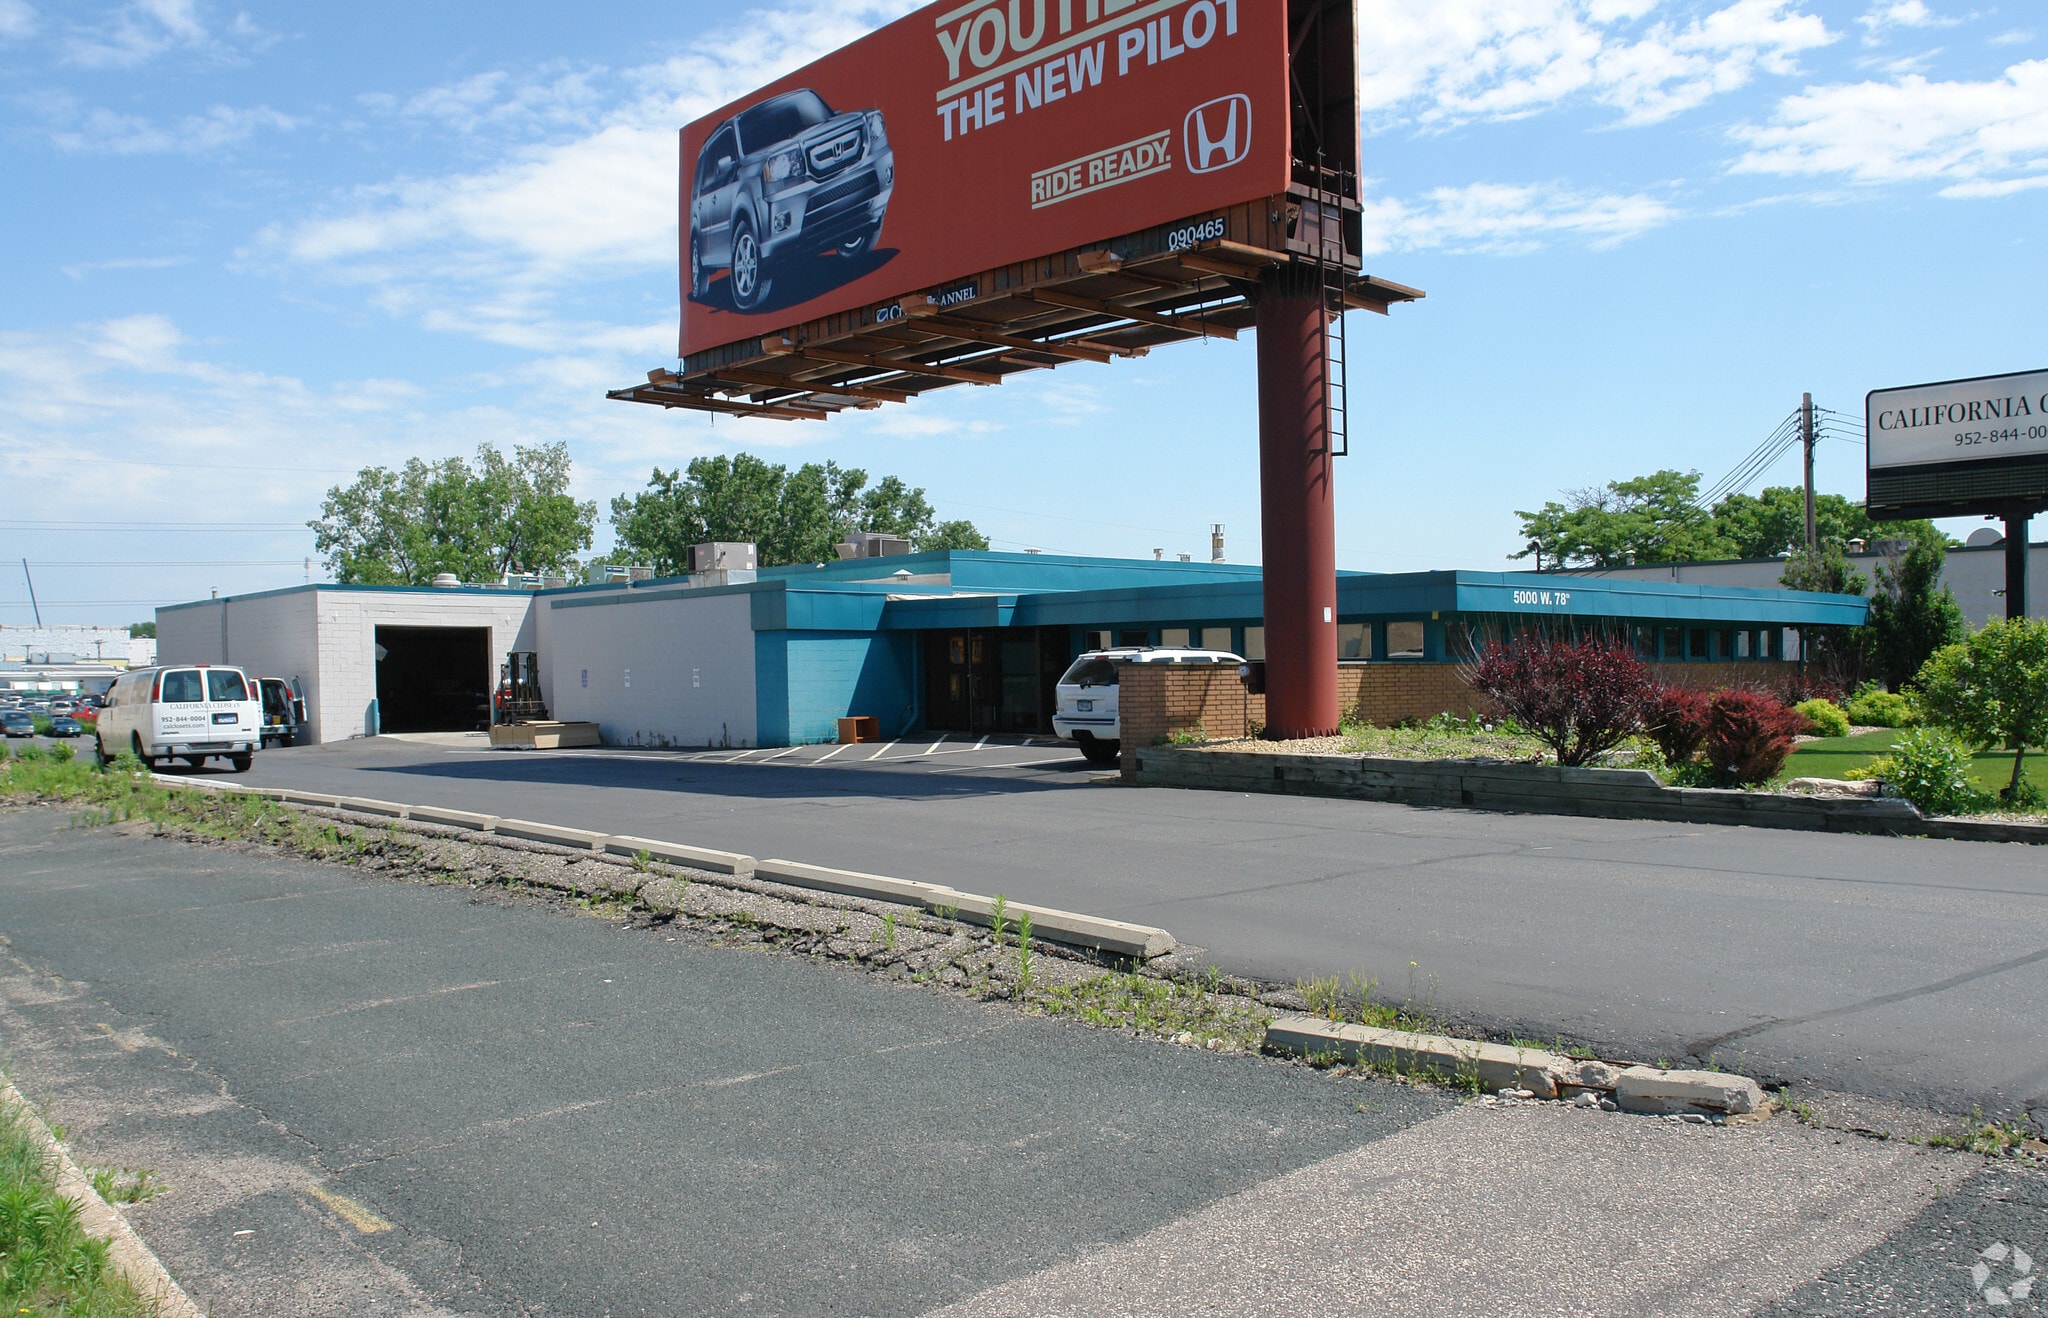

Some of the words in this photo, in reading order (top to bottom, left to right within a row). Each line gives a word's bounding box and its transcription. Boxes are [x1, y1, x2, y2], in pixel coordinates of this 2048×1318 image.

[936, 81, 1006, 142] THE
[1015, 40, 1106, 115] NEW
[1118, 0, 1238, 77] PILOT
[1031, 165, 1082, 203] RIDE
[1089, 137, 1172, 185] READY.
[1168, 218, 1224, 249] 090465
[940, 286, 976, 307] ANNEL
[1879, 396, 2032, 430] CALIFORNIA
[1954, 425, 2048, 446] 952-844-00
[1513, 590, 1537, 604] 5000
[1540, 592, 1552, 605] W.
